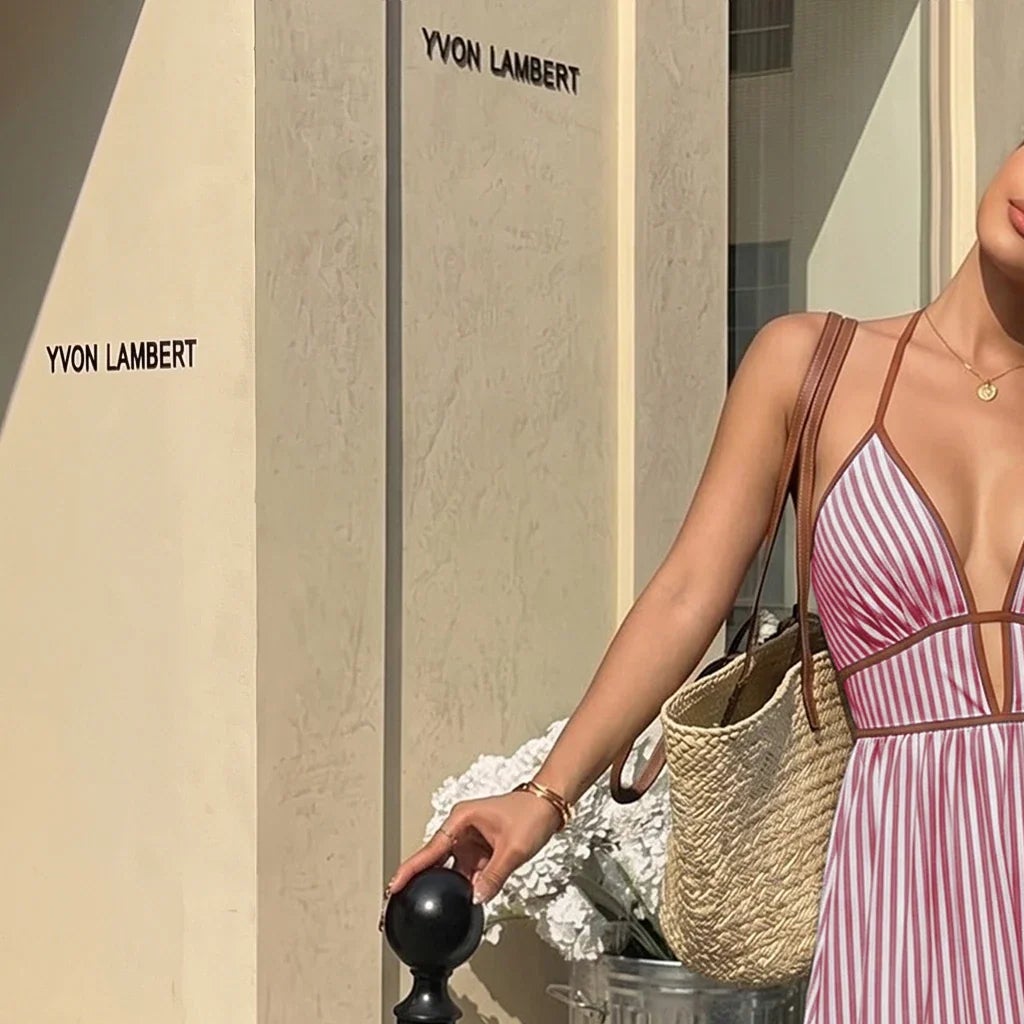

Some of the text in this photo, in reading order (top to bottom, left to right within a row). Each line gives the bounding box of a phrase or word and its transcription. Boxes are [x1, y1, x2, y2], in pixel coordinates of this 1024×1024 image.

[422, 27, 581, 95] YVON LAMBERT
[46, 339, 197, 374] YVON LAMBERT
